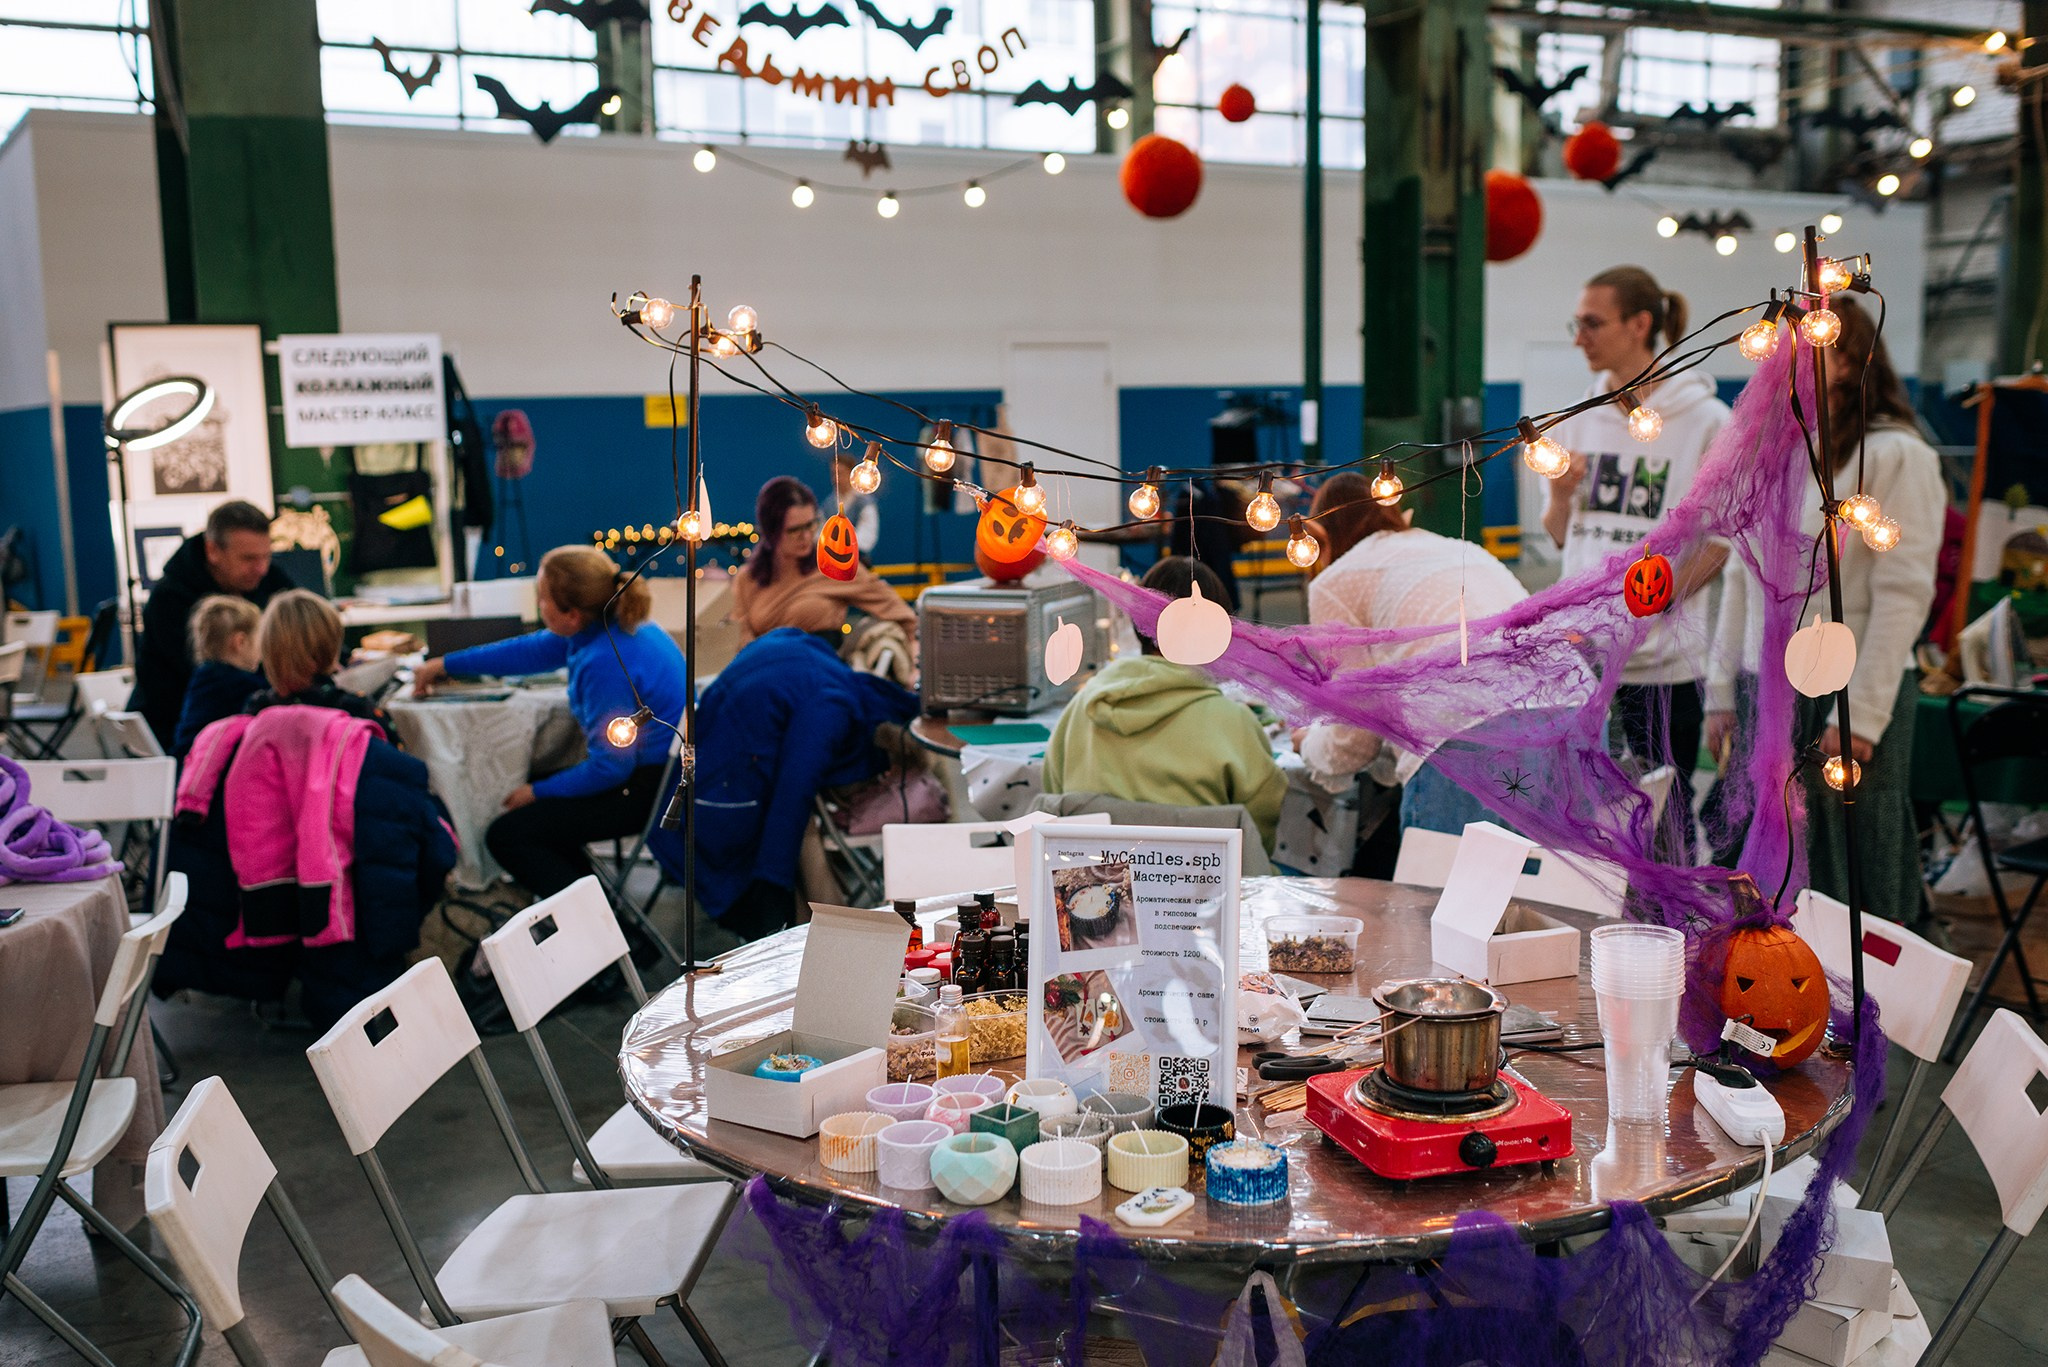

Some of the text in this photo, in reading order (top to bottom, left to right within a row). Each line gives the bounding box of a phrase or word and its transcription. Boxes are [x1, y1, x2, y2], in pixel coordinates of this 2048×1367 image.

[924, 27, 1027, 97] СВОП
[293, 344, 429, 366] СЛЕДУЮЩИЙ
[296, 372, 434, 394] КОЛЛАЖНЫЙ
[299, 404, 436, 422] МАСТЕР-КЛАСС
[1101, 850, 1221, 870] MyCandles.spb
[1133, 870, 1221, 885] Мастер-класс
[1136, 896, 1191, 904] Ароматическая
